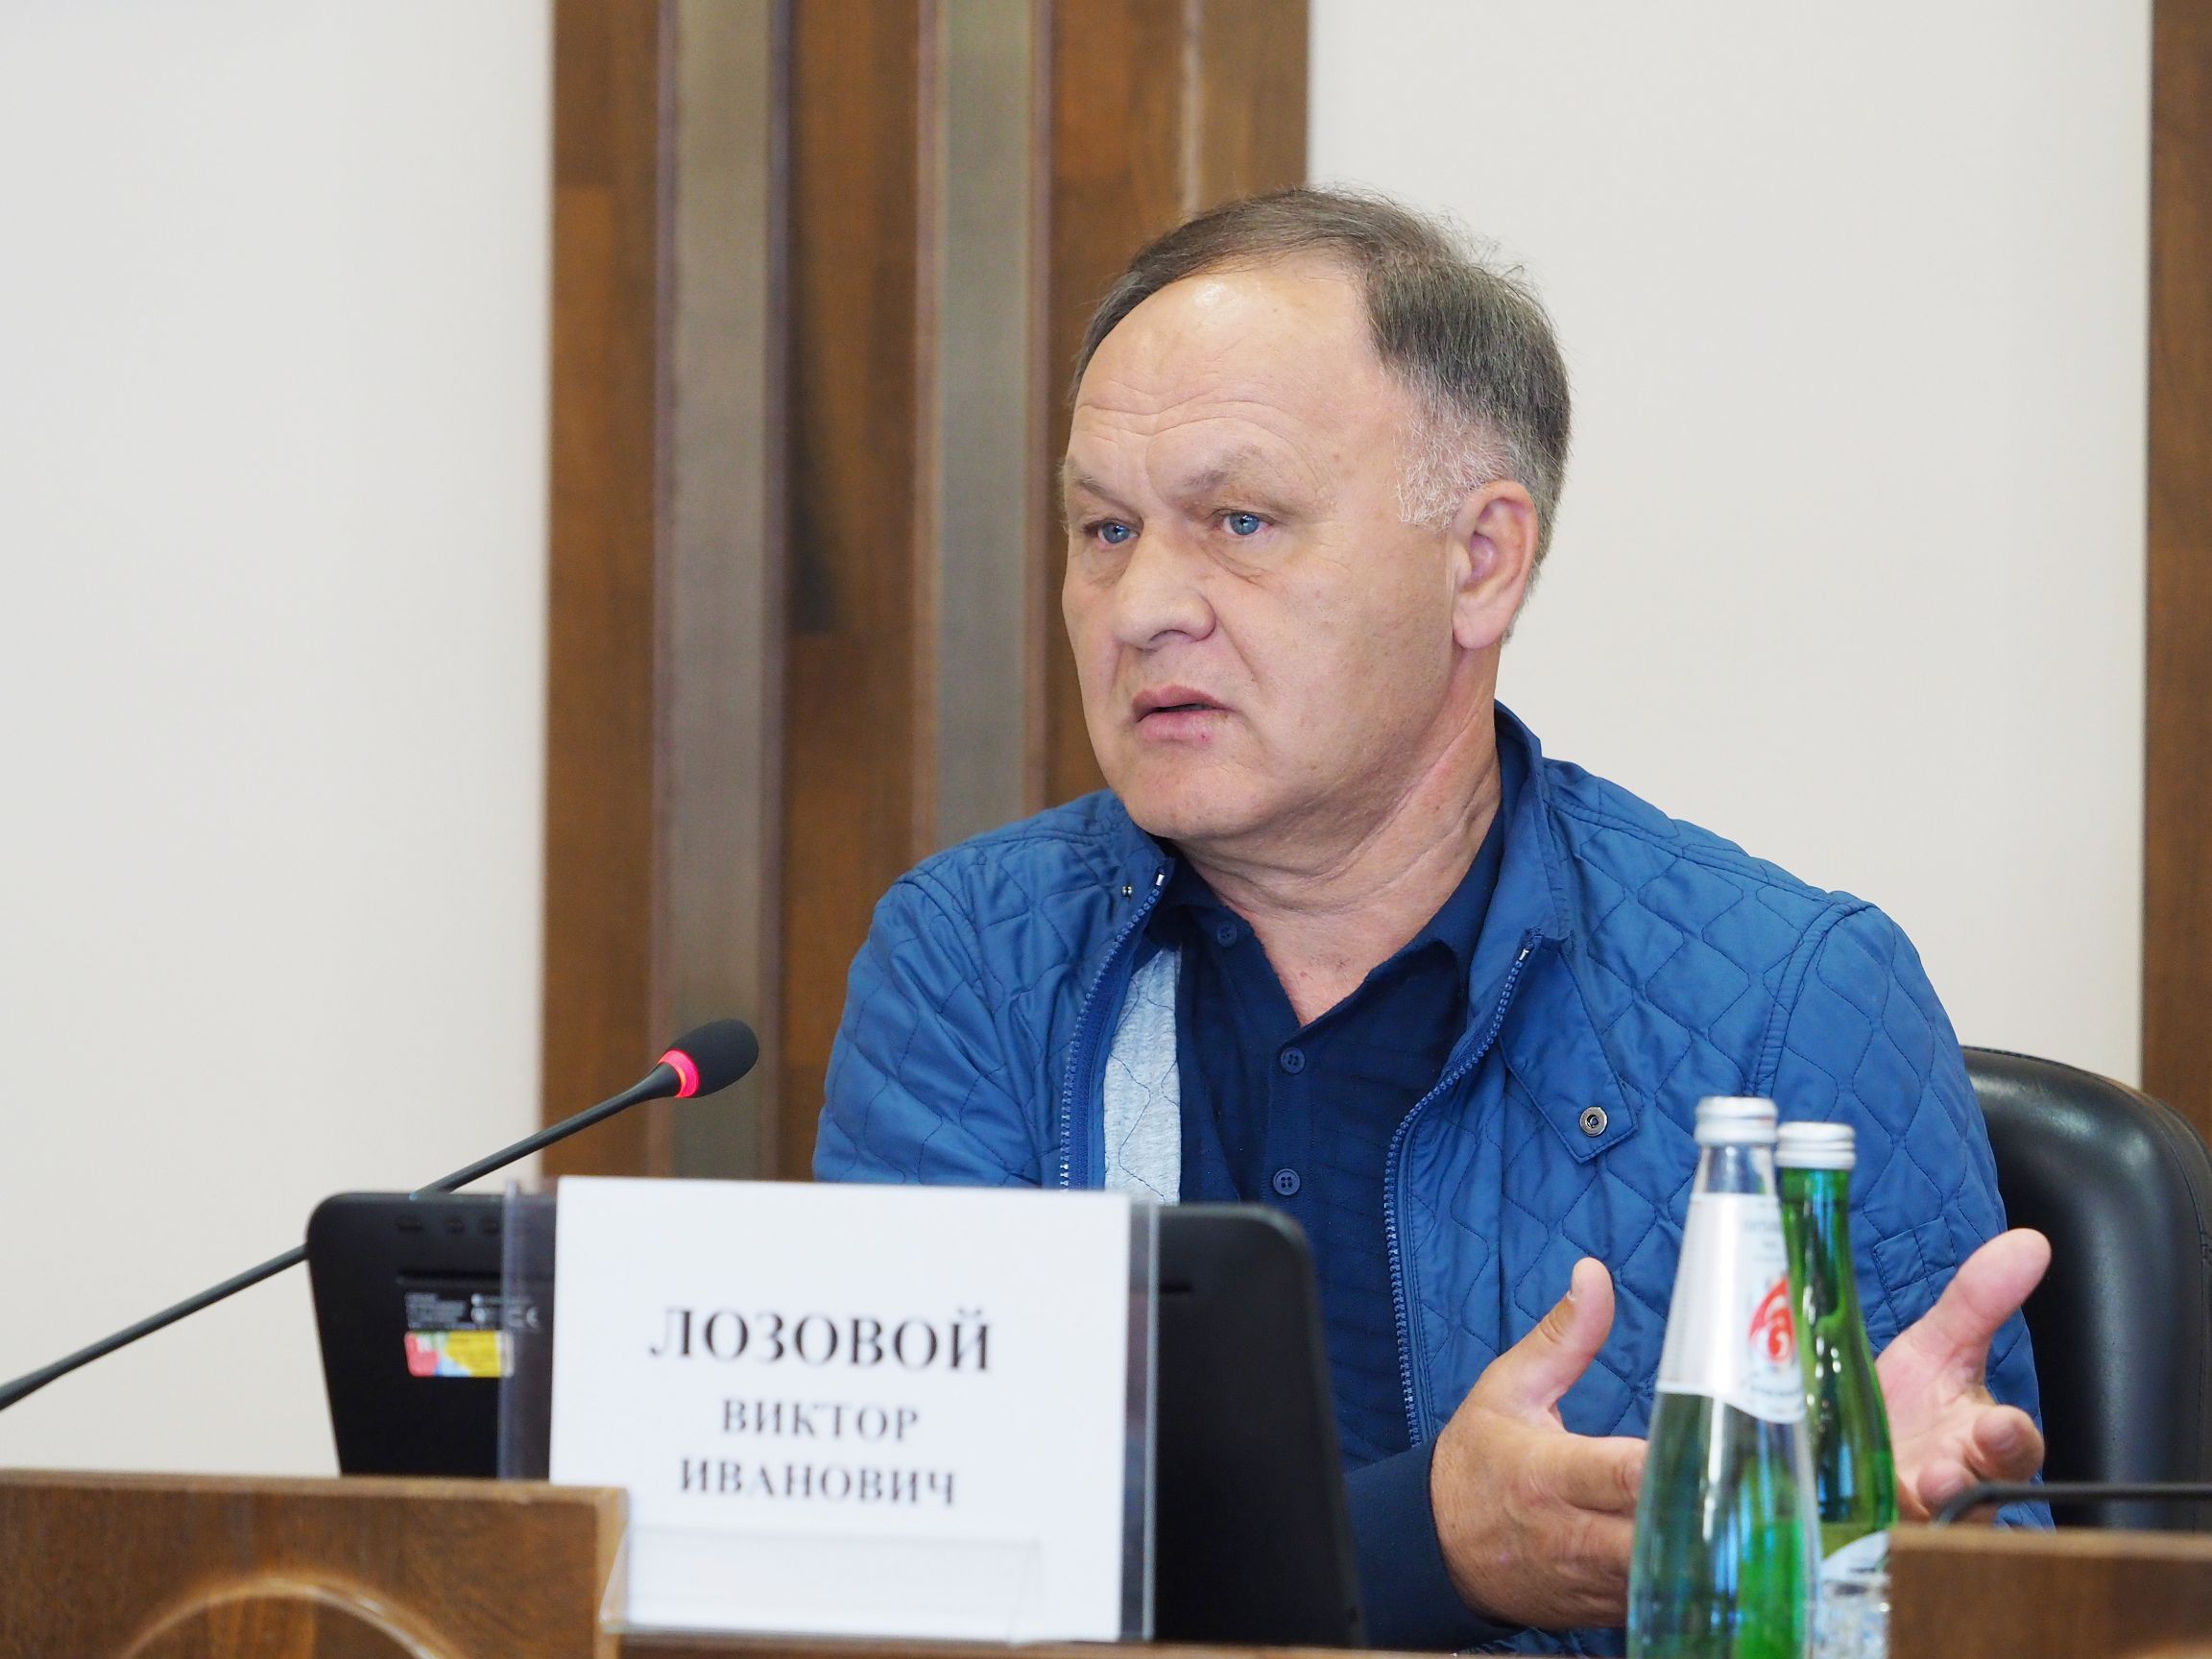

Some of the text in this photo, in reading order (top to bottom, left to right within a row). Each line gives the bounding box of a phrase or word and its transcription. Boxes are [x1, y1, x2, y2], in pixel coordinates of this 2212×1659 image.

[649, 1307, 991, 1373] ЛОЗОВОЙ
[722, 1399, 919, 1441] ВИКТОР
[680, 1458, 955, 1505] ИВАНОВИЧ
